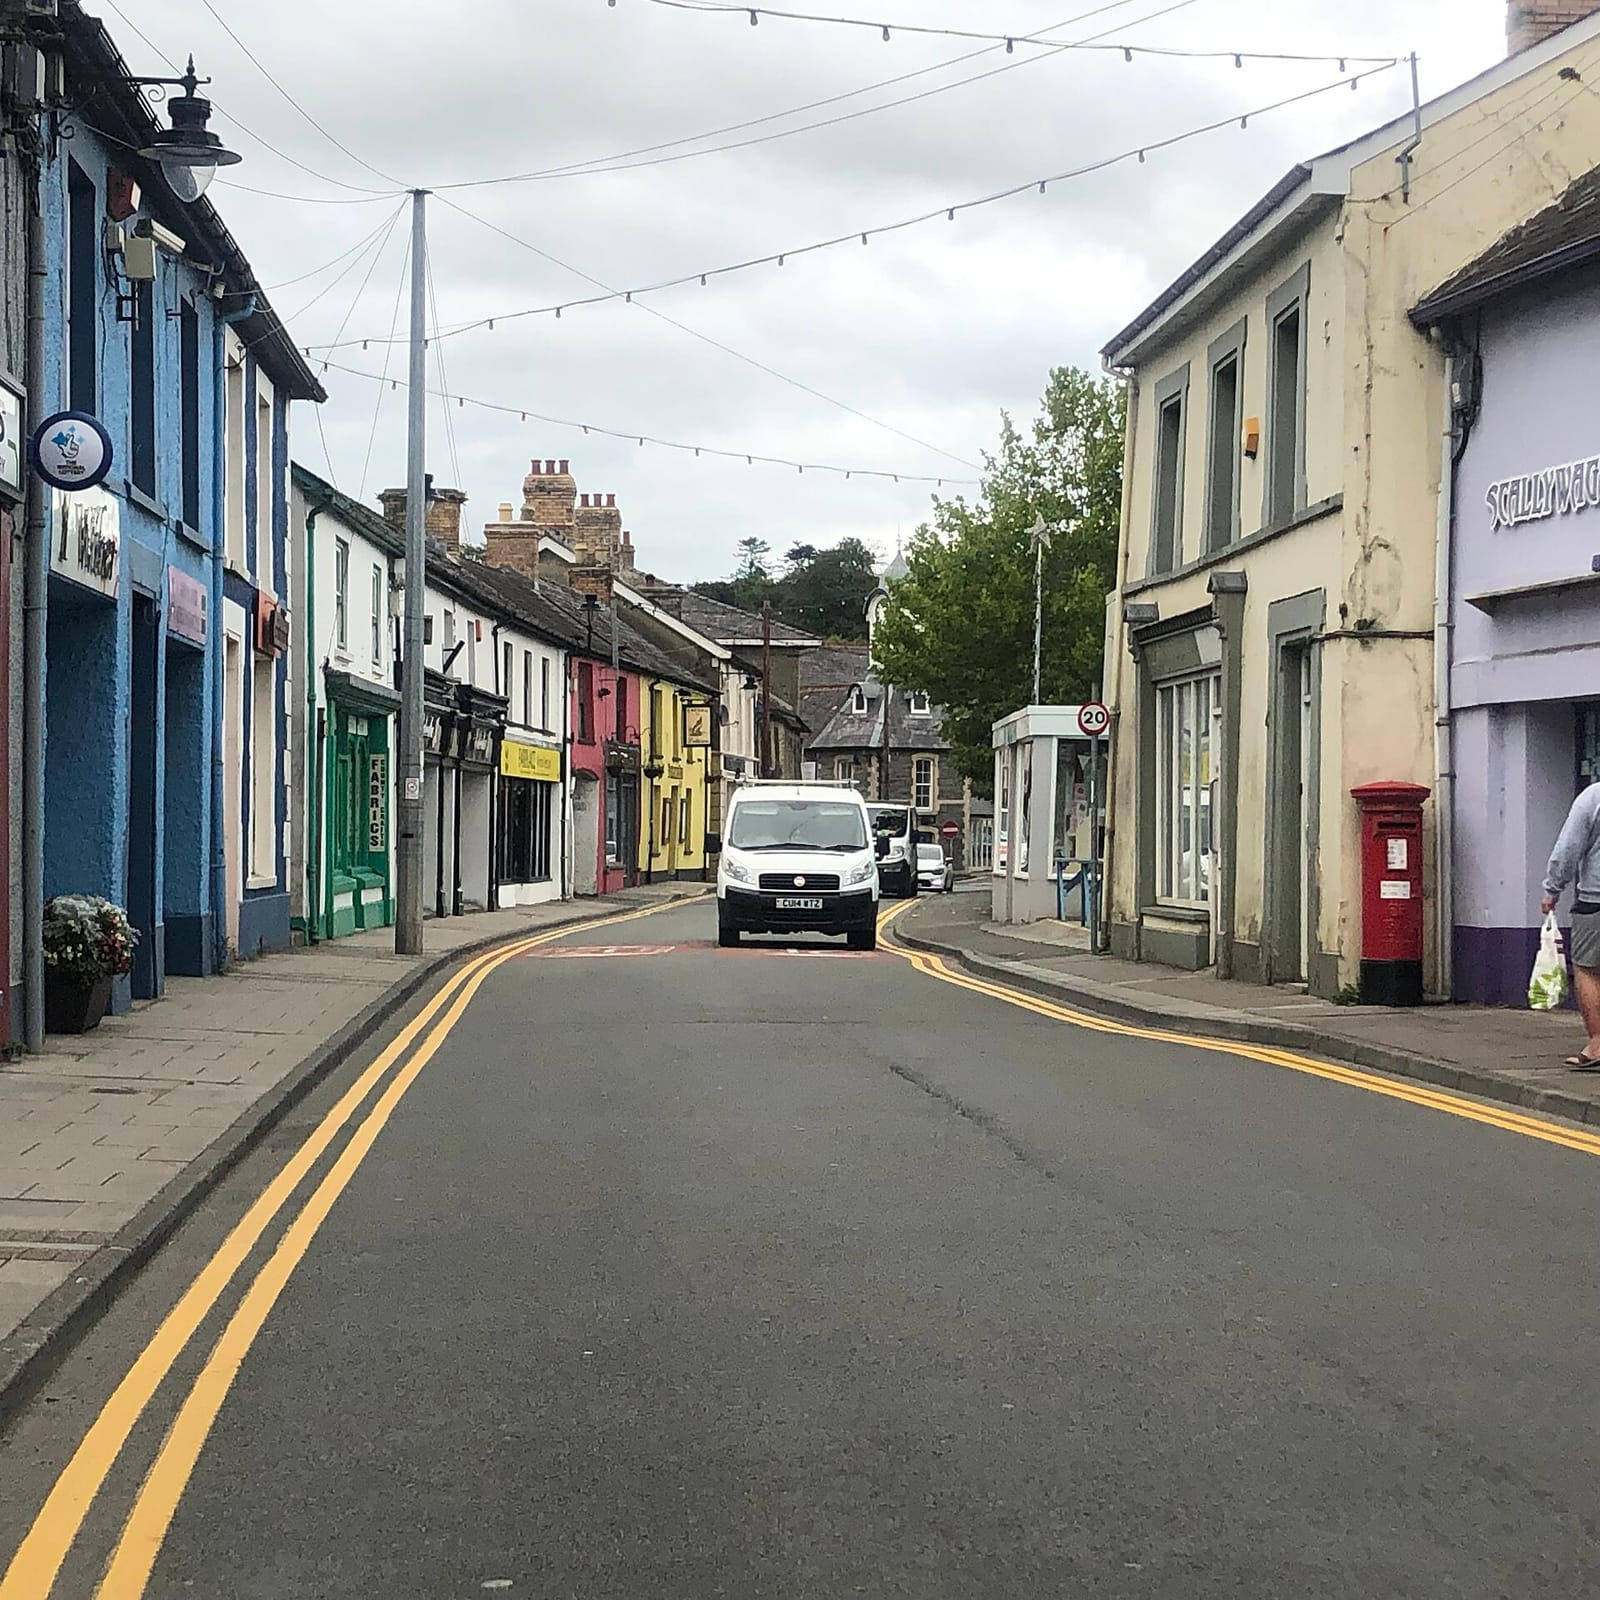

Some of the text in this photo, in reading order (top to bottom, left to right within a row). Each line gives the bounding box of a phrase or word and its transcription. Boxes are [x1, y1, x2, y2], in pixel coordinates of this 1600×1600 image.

[1485, 455, 1600, 530] SCALLYWAG
[1083, 711, 1105, 724] 20
[370, 759, 379, 847] FABRICS
